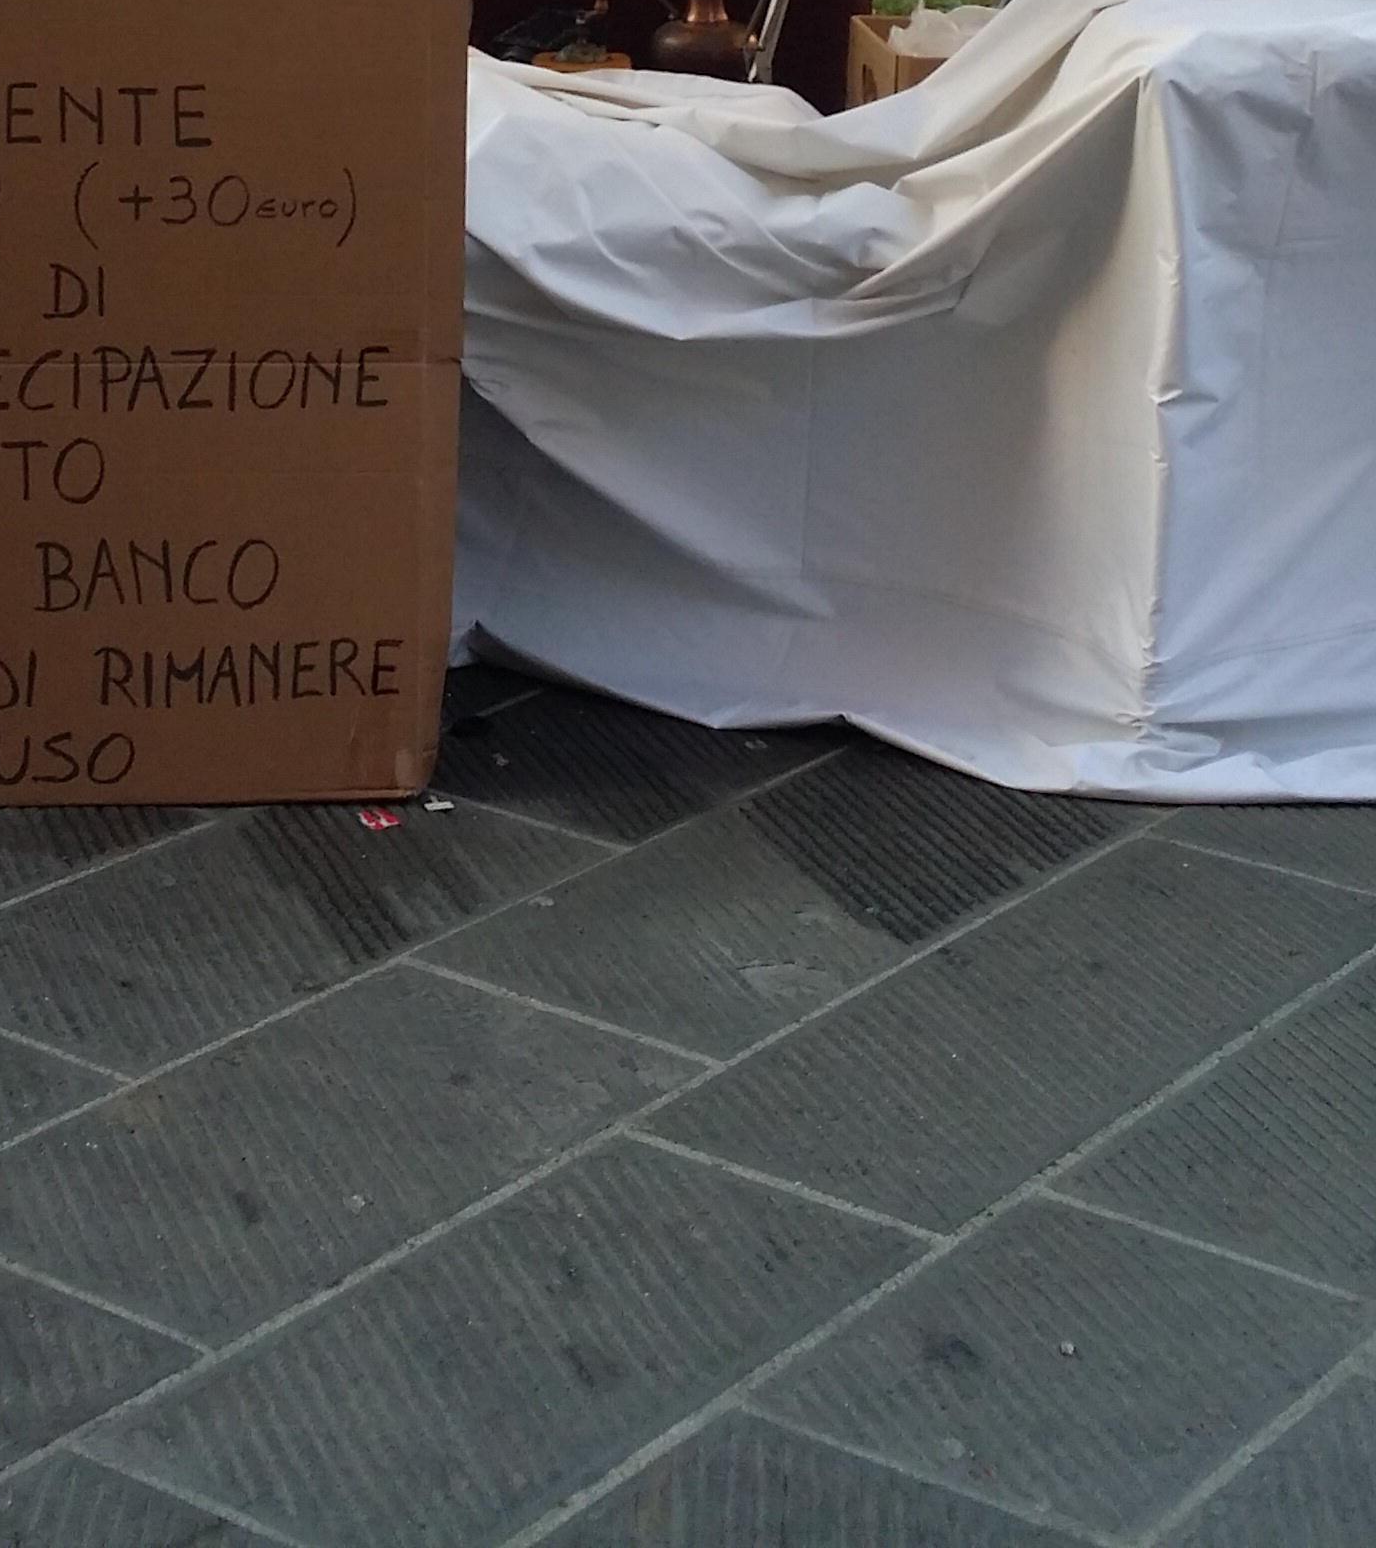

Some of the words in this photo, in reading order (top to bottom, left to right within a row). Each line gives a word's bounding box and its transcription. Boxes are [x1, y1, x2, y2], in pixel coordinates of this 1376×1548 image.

[42, 263, 104, 319] DI
[34, 538, 279, 612] BANCO
[94, 637, 404, 709] RIMANERE
